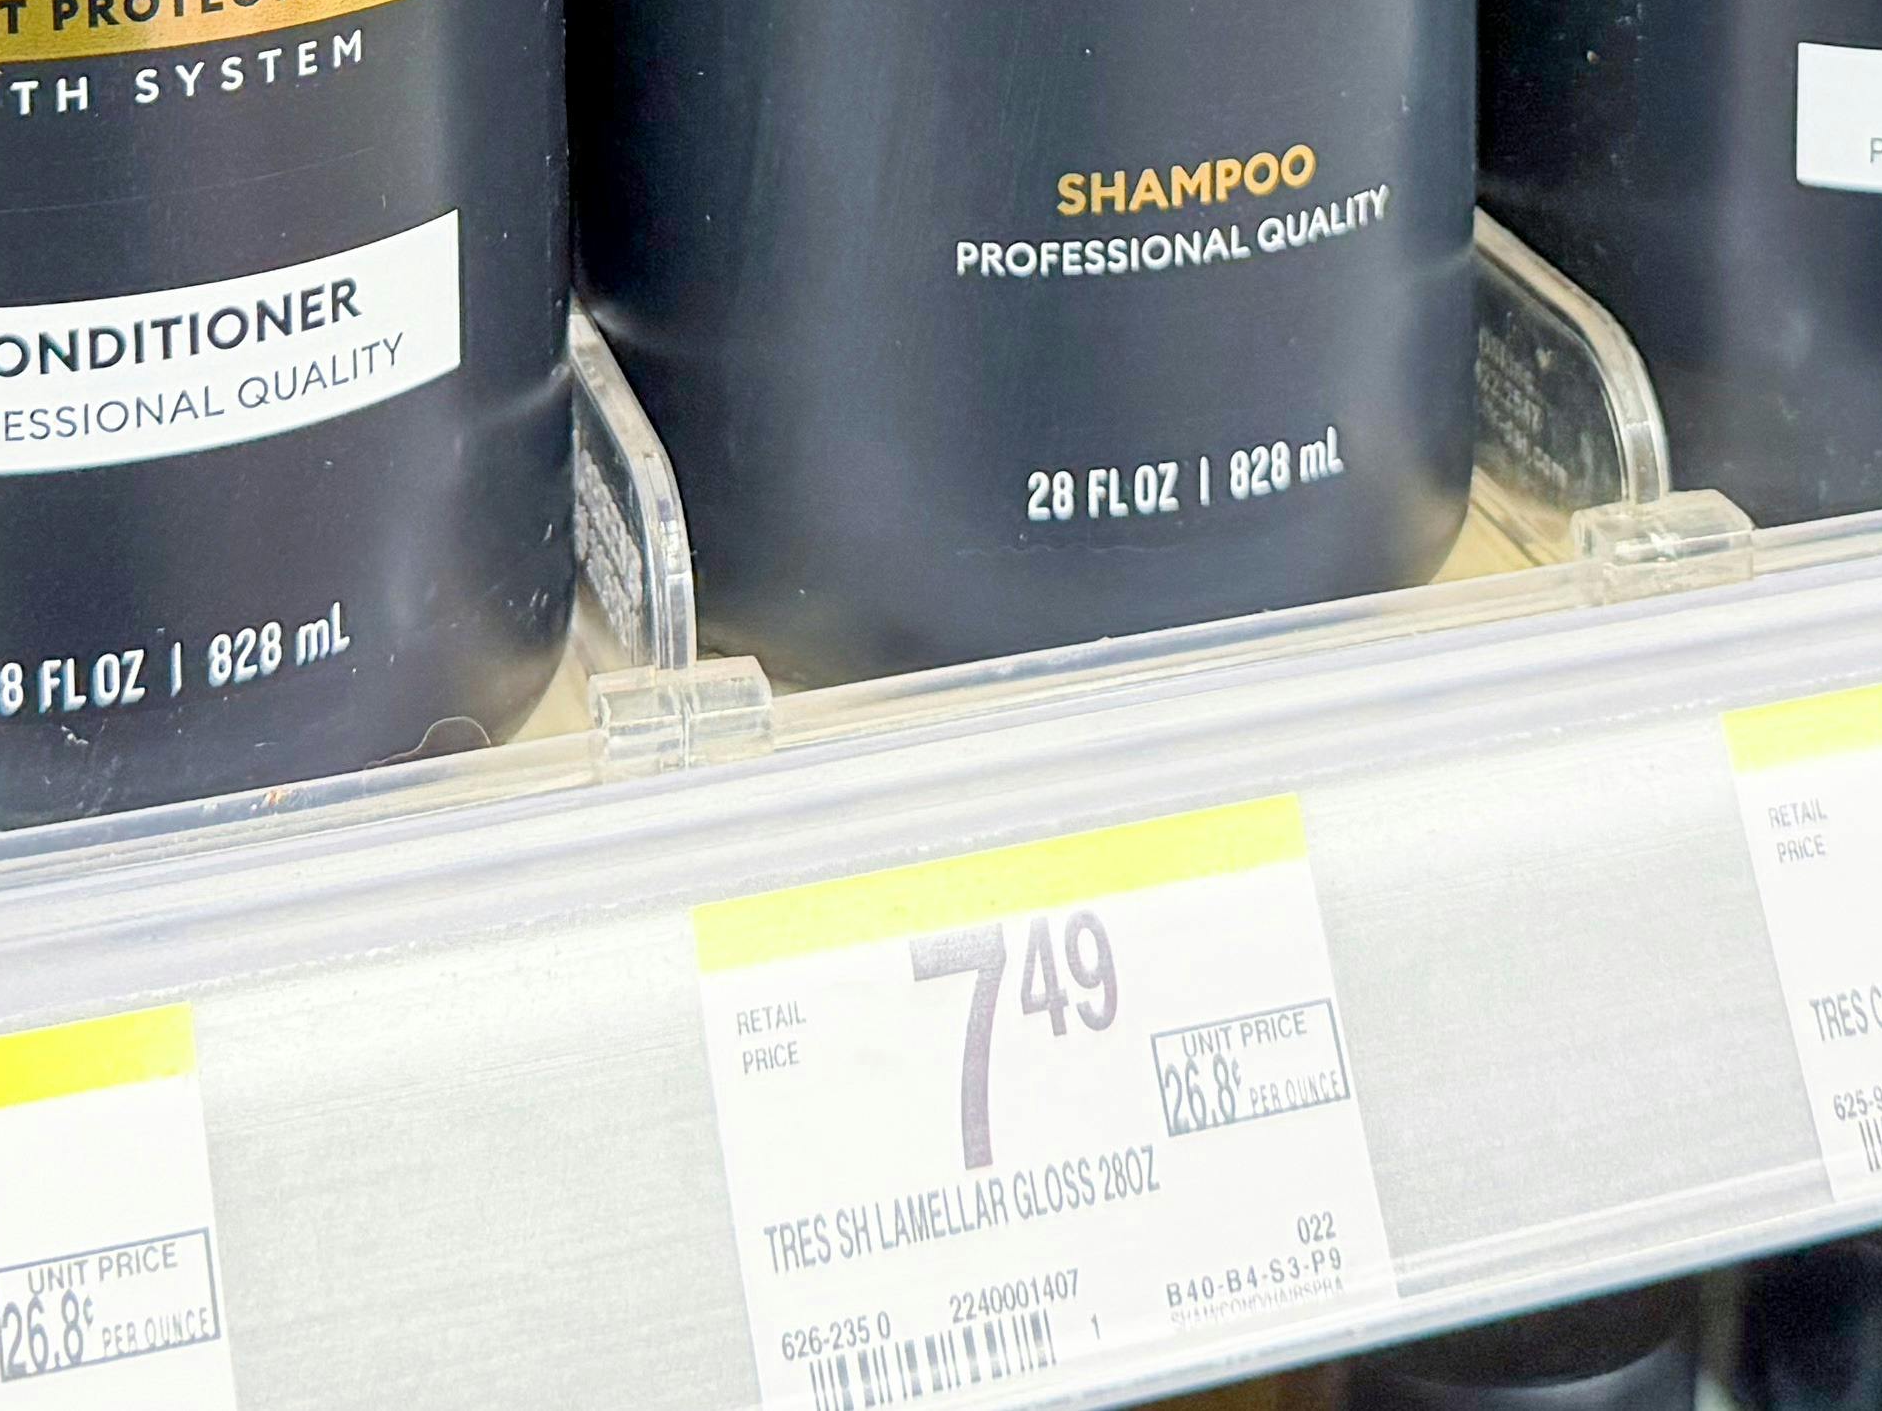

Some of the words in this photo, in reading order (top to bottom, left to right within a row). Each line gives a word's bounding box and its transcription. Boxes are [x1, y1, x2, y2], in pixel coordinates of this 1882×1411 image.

[134, 29, 364, 105] SYSTEM
[1056, 144, 1316, 216] SHAMPOO
[956, 224, 1249, 277] PROFESSIONAL
[1257, 184, 1389, 254] QUALITY
[236, 332, 405, 407] QUALITY
[1027, 471, 1074, 521] 28
[1229, 440, 1289, 499] 828
[1300, 425, 1343, 479] mL
[208, 622, 281, 684] 828
[295, 601, 350, 666] mL
[1769, 799, 1828, 828] RETAIL
[1777, 838, 1826, 864] PRICE
[736, 1001, 806, 1035] RETAIL
[1182, 1027, 1232, 1056] UNIT
[1239, 1012, 1308, 1045] PRICE
[1810, 996, 1869, 1042] TRES
[742, 1042, 800, 1073] PRICE
[1249, 1085, 1284, 1115] PER
[1284, 1069, 1346, 1109] OUNCE
[764, 1218, 832, 1274] TRES
[837, 1210, 874, 1254] SH
[876, 1175, 1010, 1249] LAMELLAR
[1014, 1159, 1094, 1218] GLOSS
[1099, 1146, 1160, 1199] 28OZ
[1297, 1212, 1337, 1245] 022
[27, 1258, 91, 1296] UNIT
[97, 1241, 179, 1281] PRICE
[949, 1269, 1082, 1322] 2240001407
[102, 1324, 140, 1357] PER
[145, 1306, 218, 1350] OUNCE
[781, 1318, 873, 1361] 626-235
